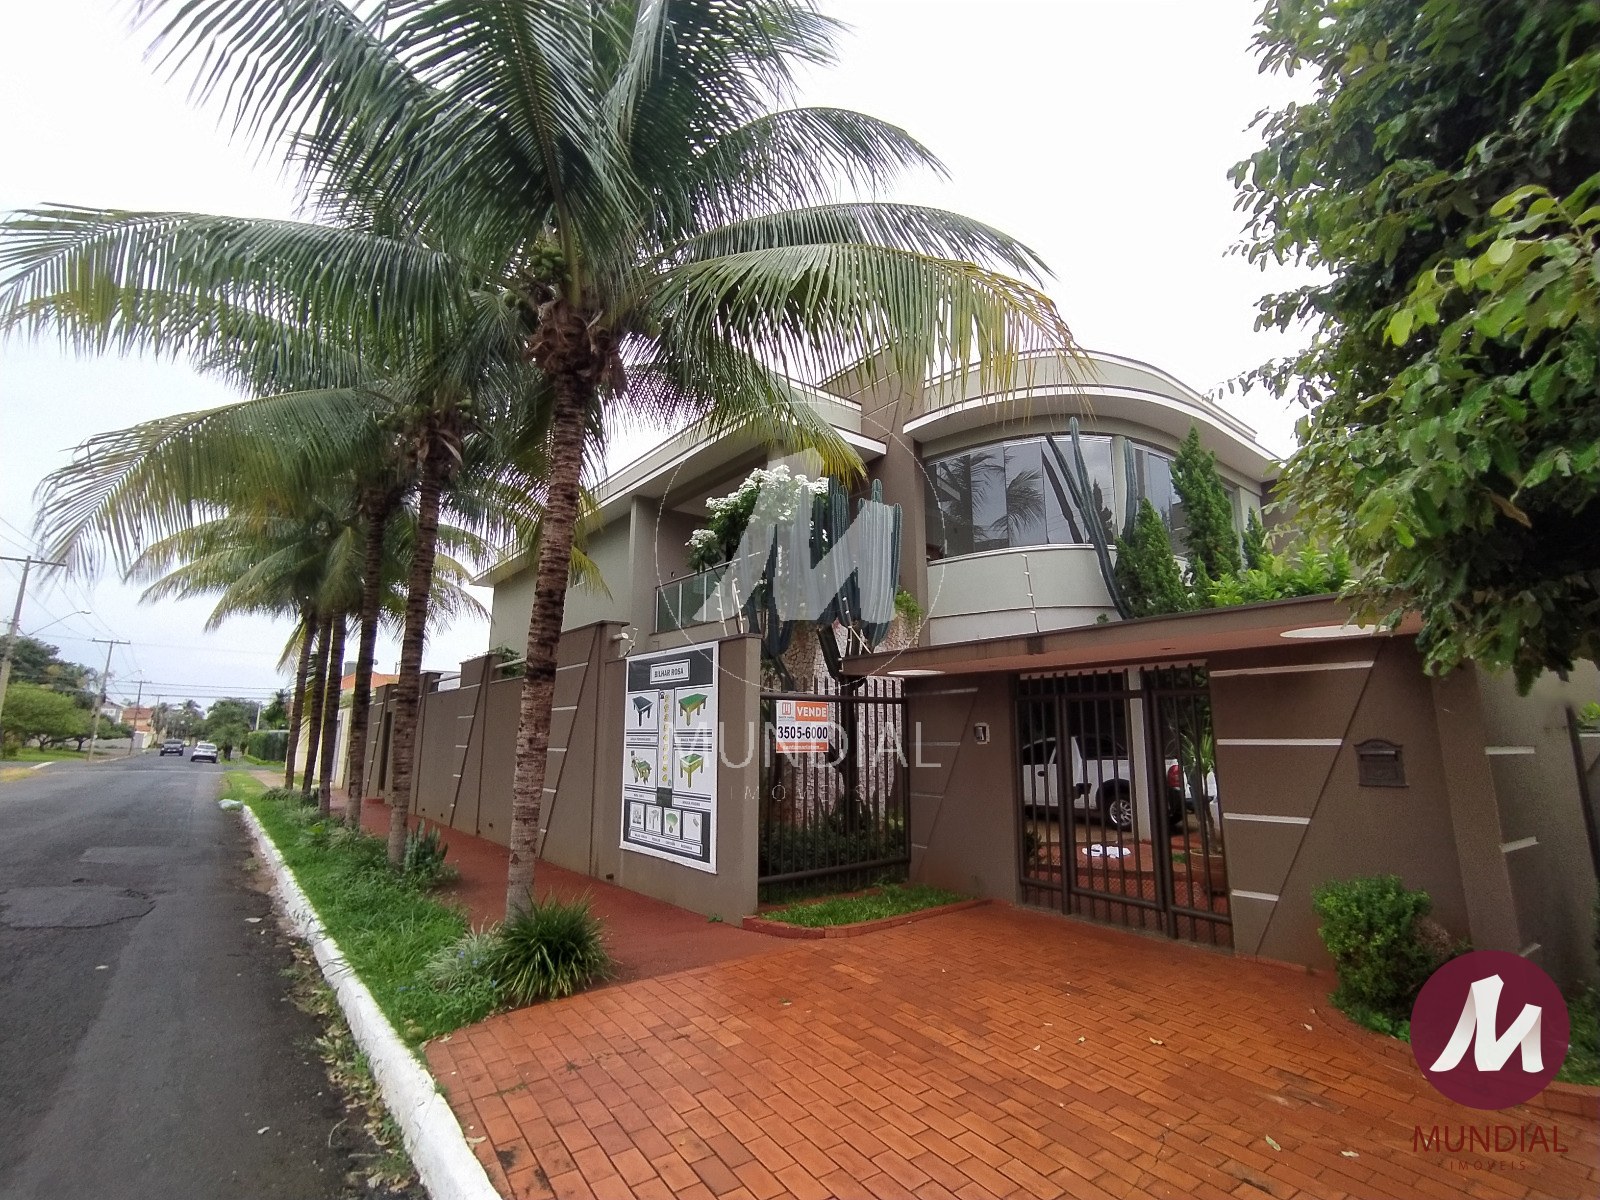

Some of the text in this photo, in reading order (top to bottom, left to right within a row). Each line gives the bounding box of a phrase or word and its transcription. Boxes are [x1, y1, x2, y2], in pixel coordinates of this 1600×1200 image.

[654, 667, 684, 678] BILHAR ROSA
[796, 706, 827, 717] VENDE
[778, 726, 828, 739] 3505-6000
